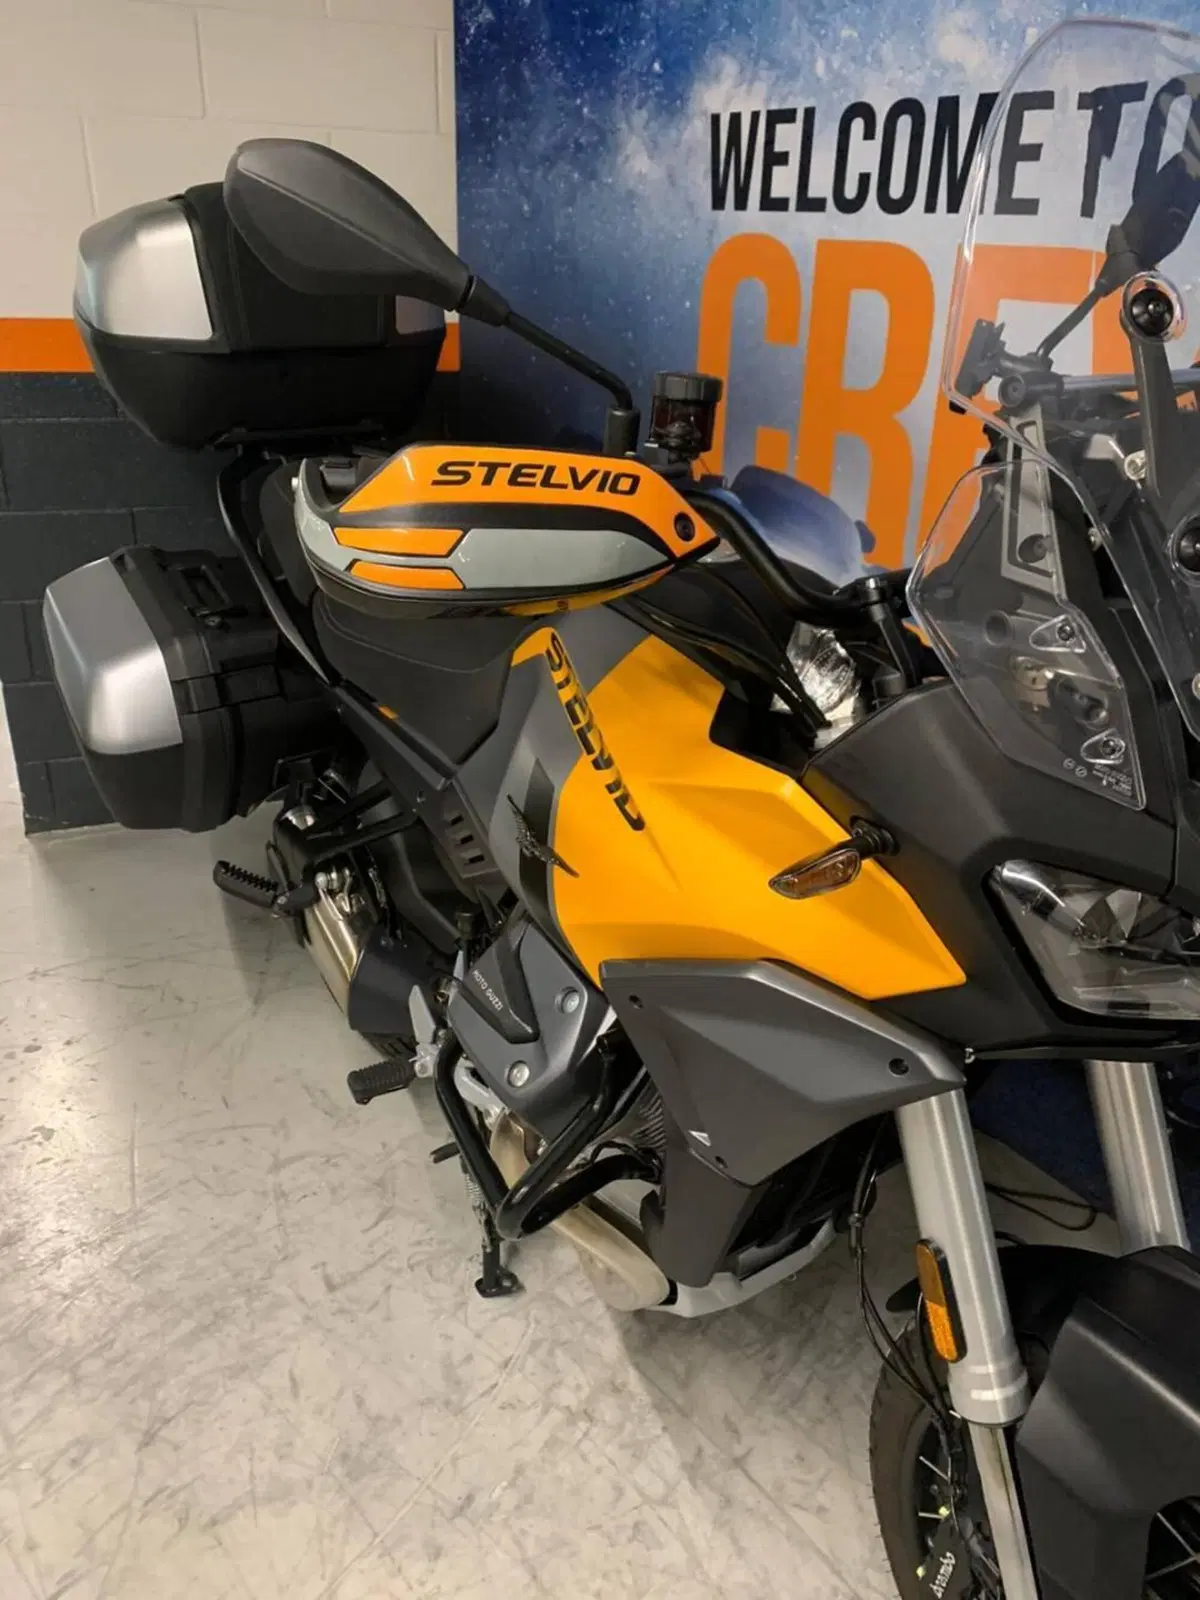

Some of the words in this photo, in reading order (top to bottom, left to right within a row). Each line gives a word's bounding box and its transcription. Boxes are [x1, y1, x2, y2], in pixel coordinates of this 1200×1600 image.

[710, 90, 1055, 217] WELCOME
[431, 460, 641, 496] STELVIO
[546, 631, 646, 831] STELVIO
[472, 969, 488, 990] MOTO
[485, 988, 504, 1012] GUZZI
